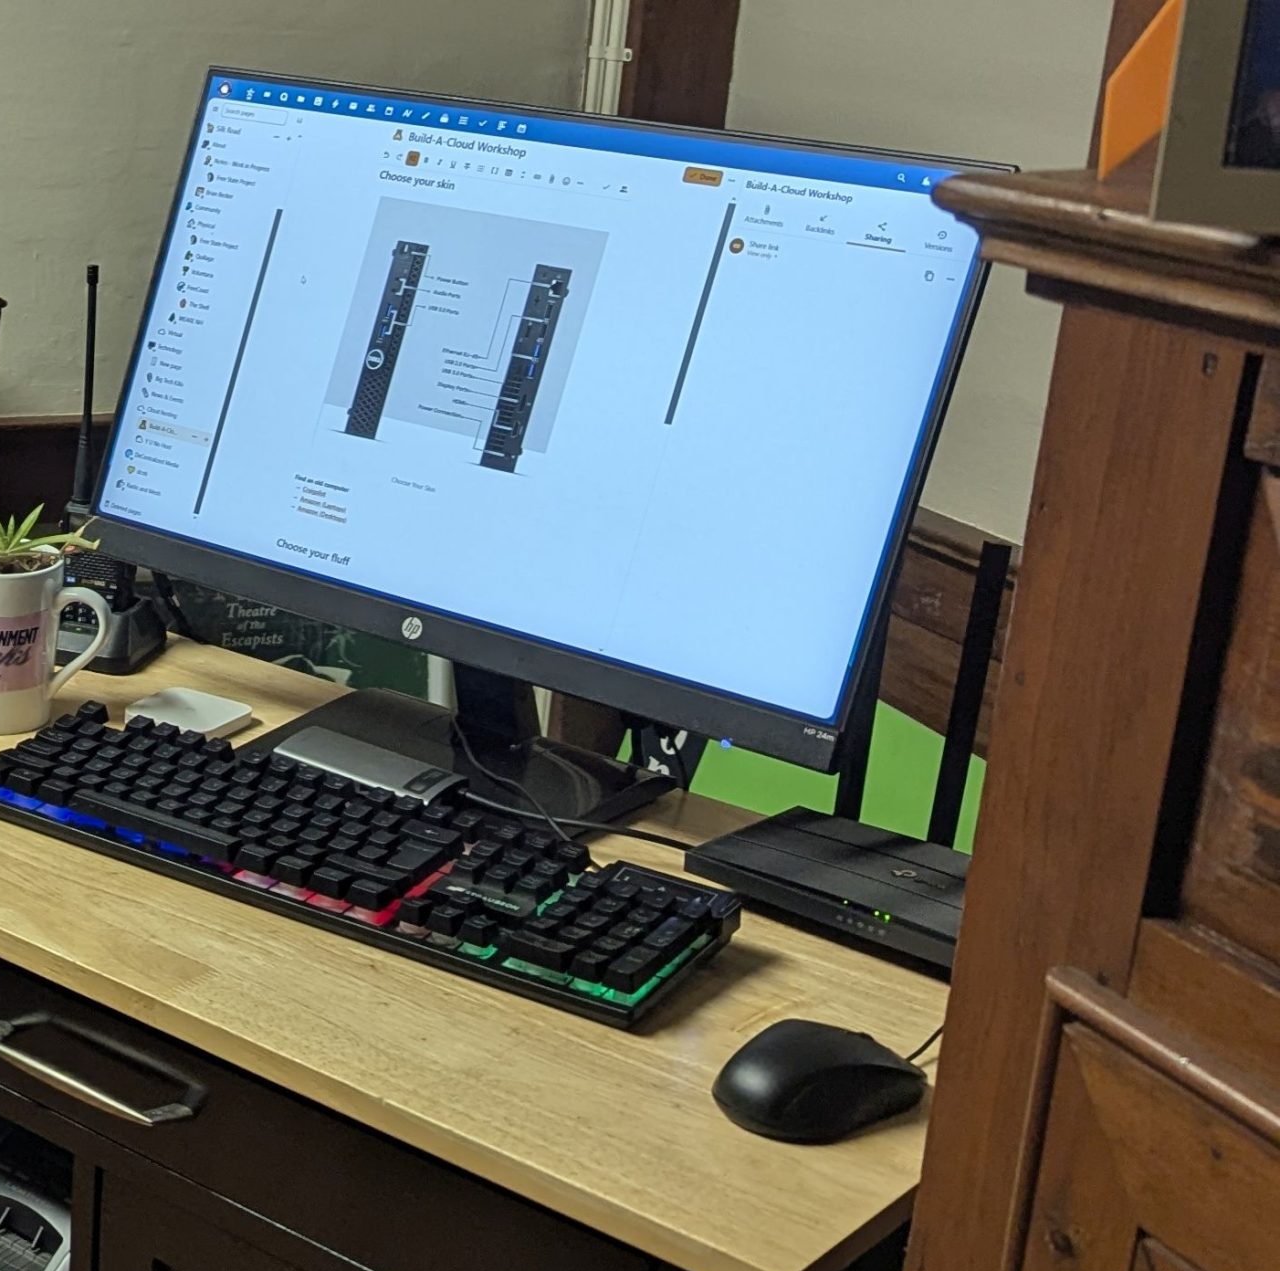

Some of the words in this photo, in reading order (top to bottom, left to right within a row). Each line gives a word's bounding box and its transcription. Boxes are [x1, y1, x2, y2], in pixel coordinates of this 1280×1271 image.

[408, 131, 475, 151] Build-A-Cloud
[476, 140, 527, 159] Workshop
[379, 169, 412, 185] Choose
[413, 176, 436, 189] your
[436, 178, 455, 190] skin
[745, 180, 807, 197] Build-A-Cloud
[808, 188, 854, 204] Workshop
[749, 240, 767, 250] Share
[768, 242, 779, 251] link
[864, 233, 893, 245] Sharing
[924, 242, 953, 253] Versions
[276, 538, 308, 555] Choose
[308, 547, 330, 560] your
[330, 552, 351, 566] fluff
[227, 602, 278, 618] Theatre
[237, 620, 249, 632] of
[404, 617, 421, 639] hp
[222, 632, 284, 650] Escapists
[803, 727, 817, 736] HP
